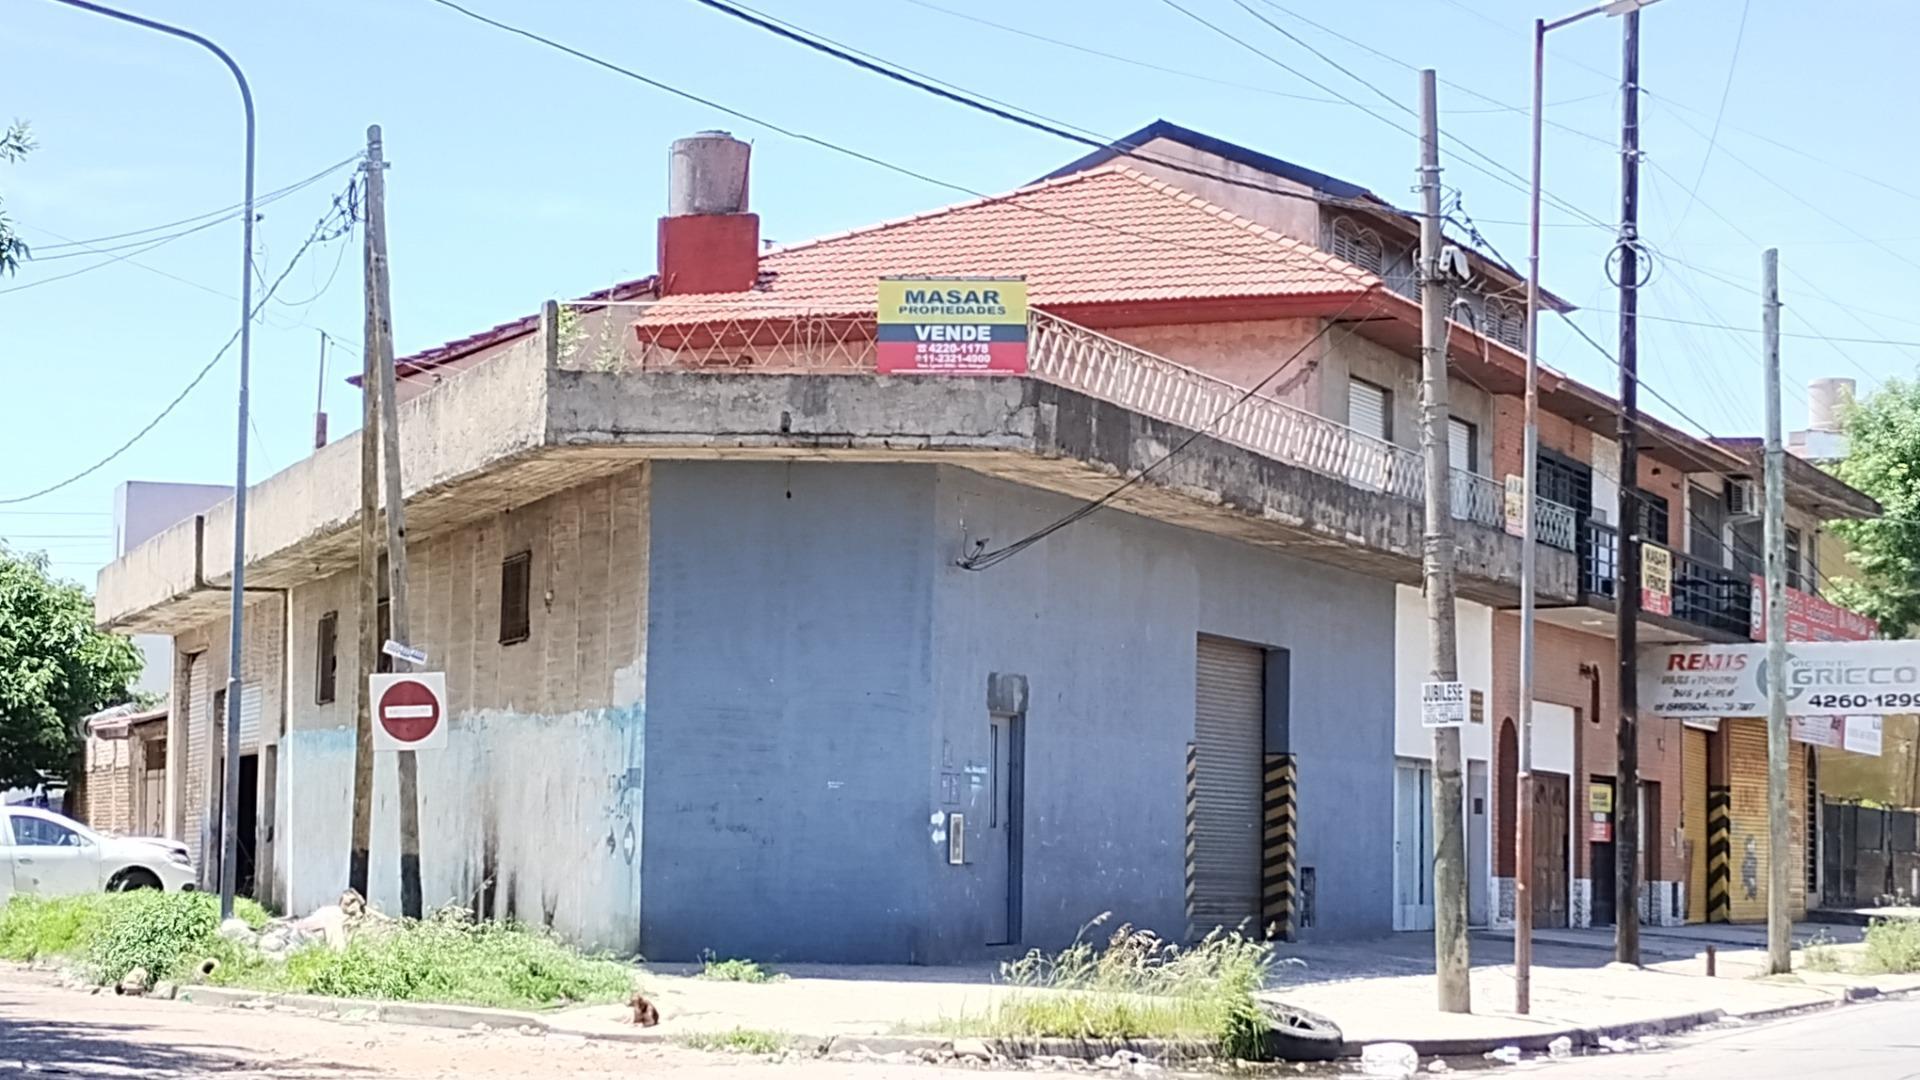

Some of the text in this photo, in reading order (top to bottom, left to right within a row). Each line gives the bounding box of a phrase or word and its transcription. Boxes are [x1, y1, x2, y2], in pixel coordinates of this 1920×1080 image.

[904, 289, 1000, 305] MASAR
[898, 305, 1007, 316] PROPIEDADES
[914, 325, 991, 342] VENDE
[1667, 654, 1748, 671] REMIS
[1792, 667, 1917, 686] GRIECO
[1424, 684, 1463, 702] JUBILESE
[1808, 692, 1920, 708] 4260-1299
